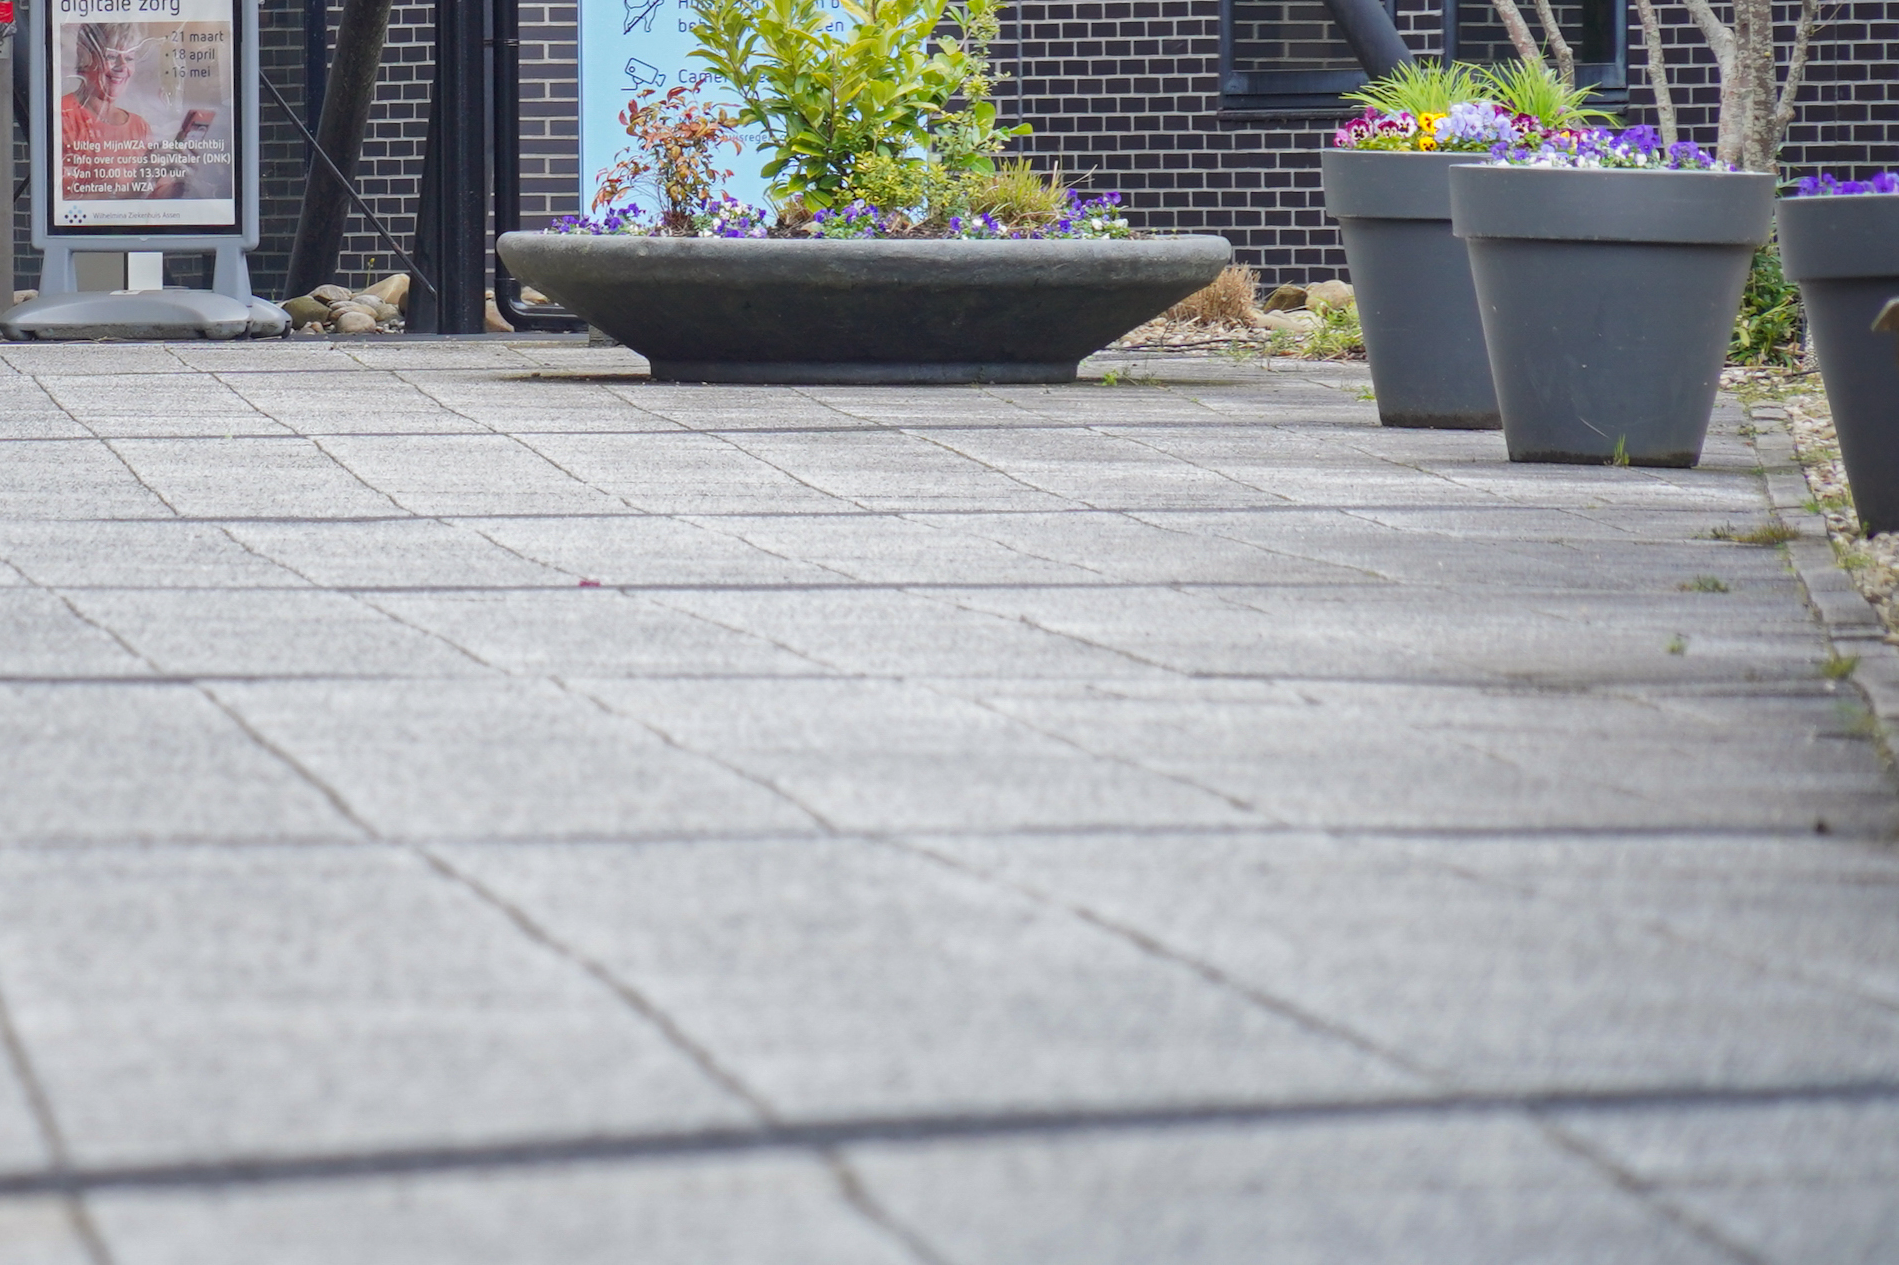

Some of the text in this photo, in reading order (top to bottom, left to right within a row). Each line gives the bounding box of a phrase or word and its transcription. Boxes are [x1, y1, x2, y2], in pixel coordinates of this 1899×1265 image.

[172, 31, 224, 43] 21 maart
[172, 48, 215, 63] 18 april
[172, 66, 211, 79] 16 mei
[73, 139, 225, 152] Uitleg MijnWZA en BeterDichtbij
[73, 153, 231, 166] Info over cursus DigiVitaler (DNK)
[73, 168, 186, 178] Van 10.00 tot 13.30 uur
[73, 182, 154, 193] Centrale hal WZA
[93, 211, 181, 220] Wilhelmina Ziekenhuis Assen
